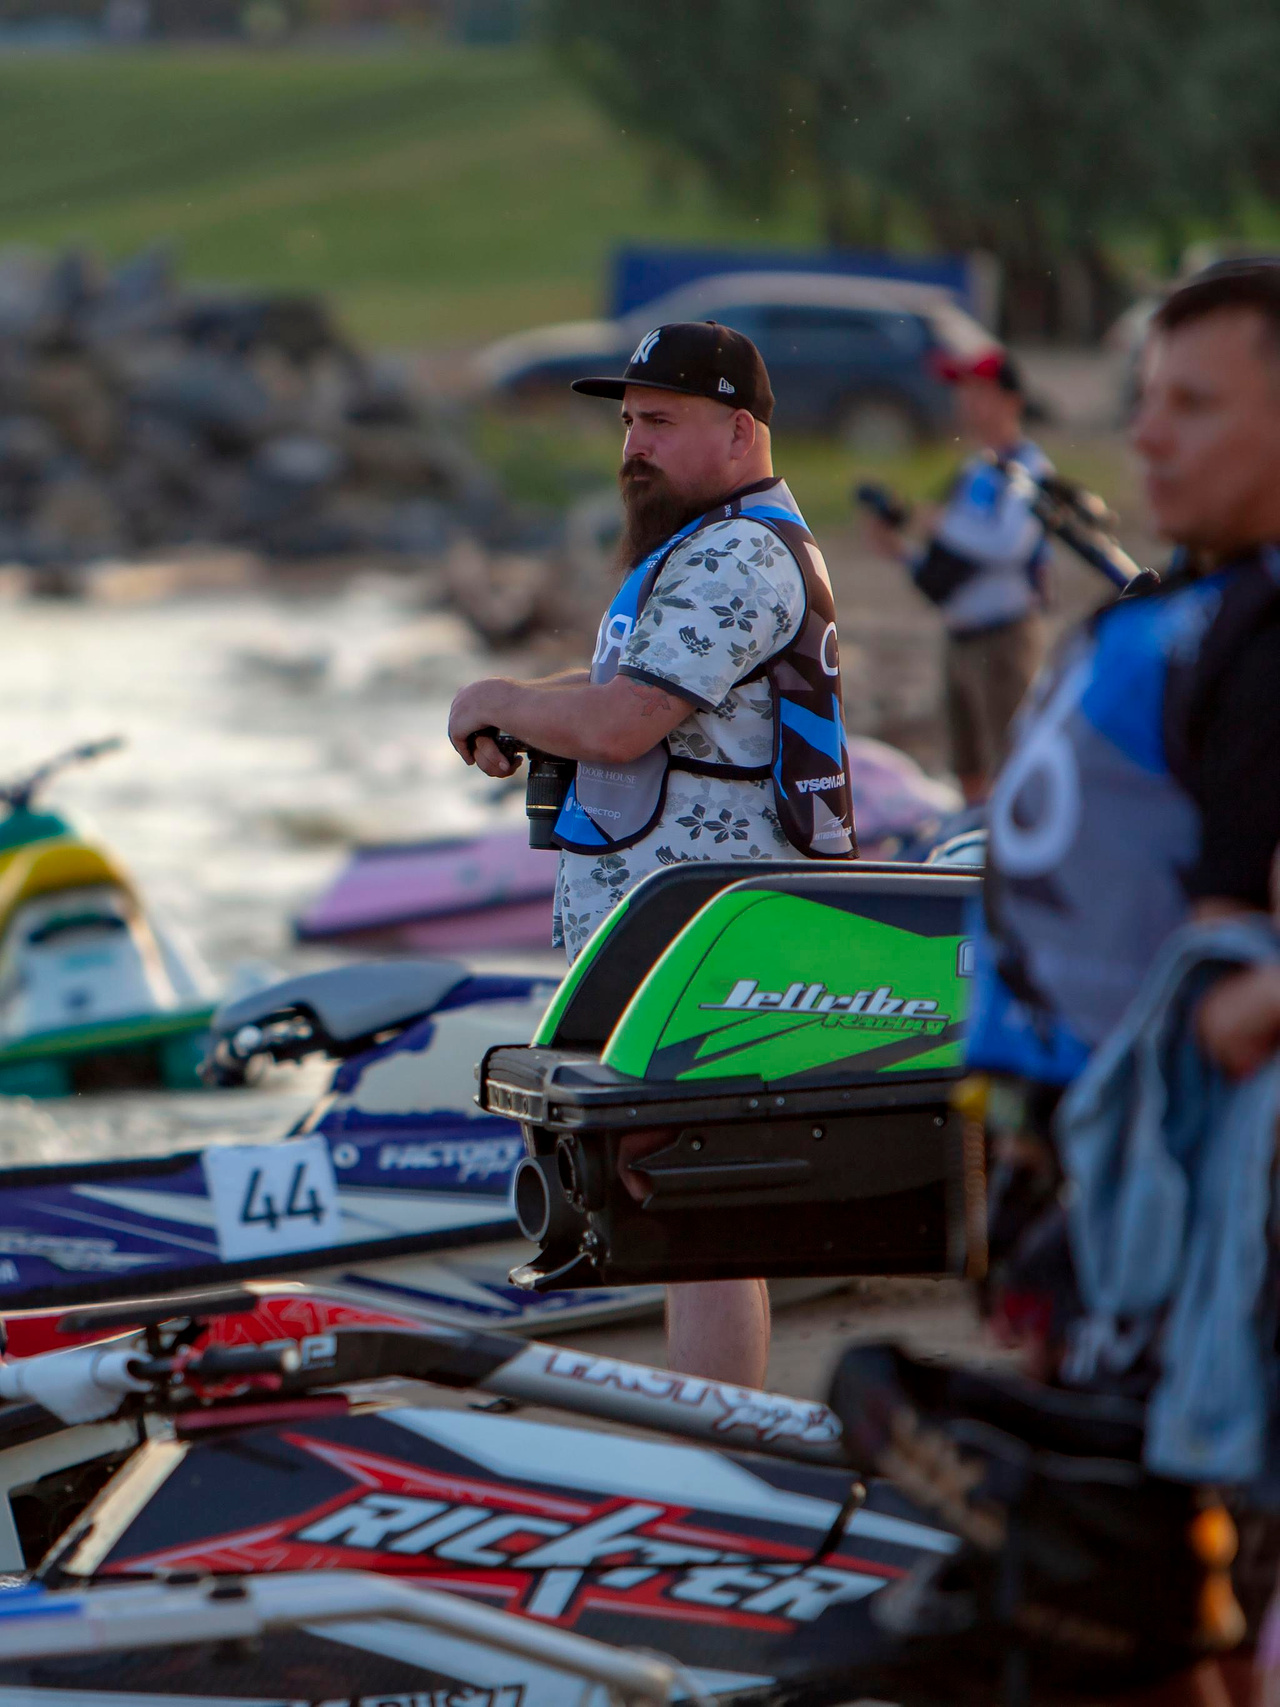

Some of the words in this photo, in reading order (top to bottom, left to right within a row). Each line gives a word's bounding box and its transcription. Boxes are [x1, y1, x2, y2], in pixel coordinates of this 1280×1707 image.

[605, 769, 638, 785] HOUSE
[239, 1160, 325, 1232] 44
[297, 1493, 889, 1622] RICKTER
